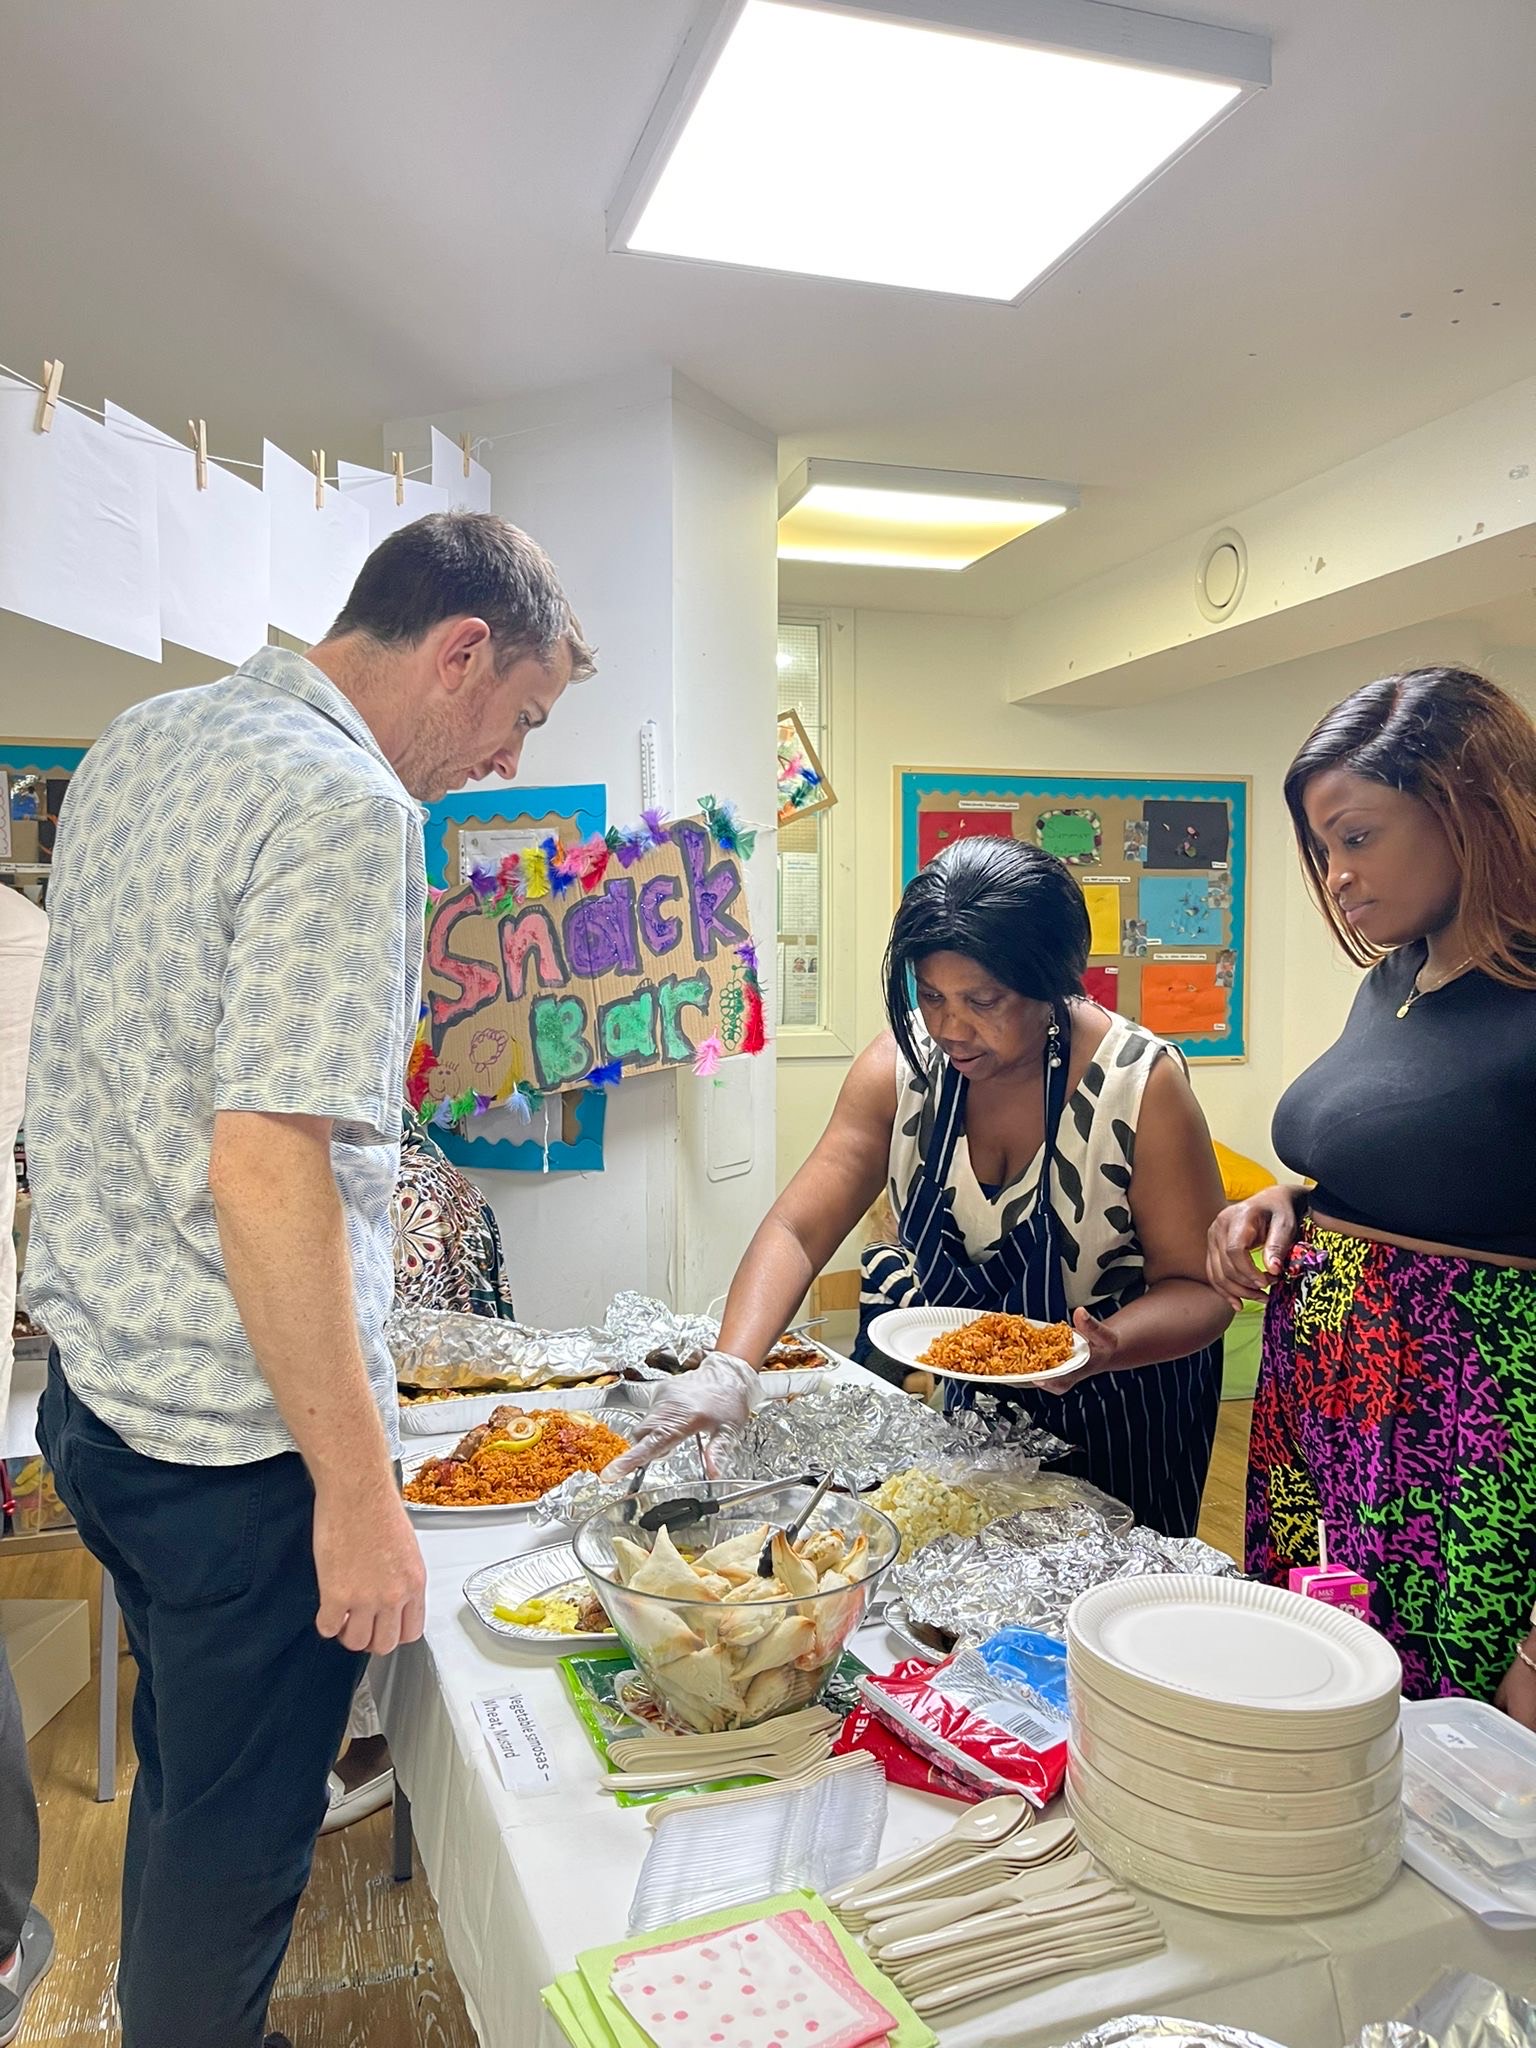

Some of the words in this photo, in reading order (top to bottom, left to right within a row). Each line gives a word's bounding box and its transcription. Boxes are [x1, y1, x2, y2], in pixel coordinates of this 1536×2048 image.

[427, 817, 750, 1053] Snack
[529, 968, 713, 1091] Bar
[1317, 1588, 1335, 1597] M&S
[482, 1698, 502, 1730] Wheat,
